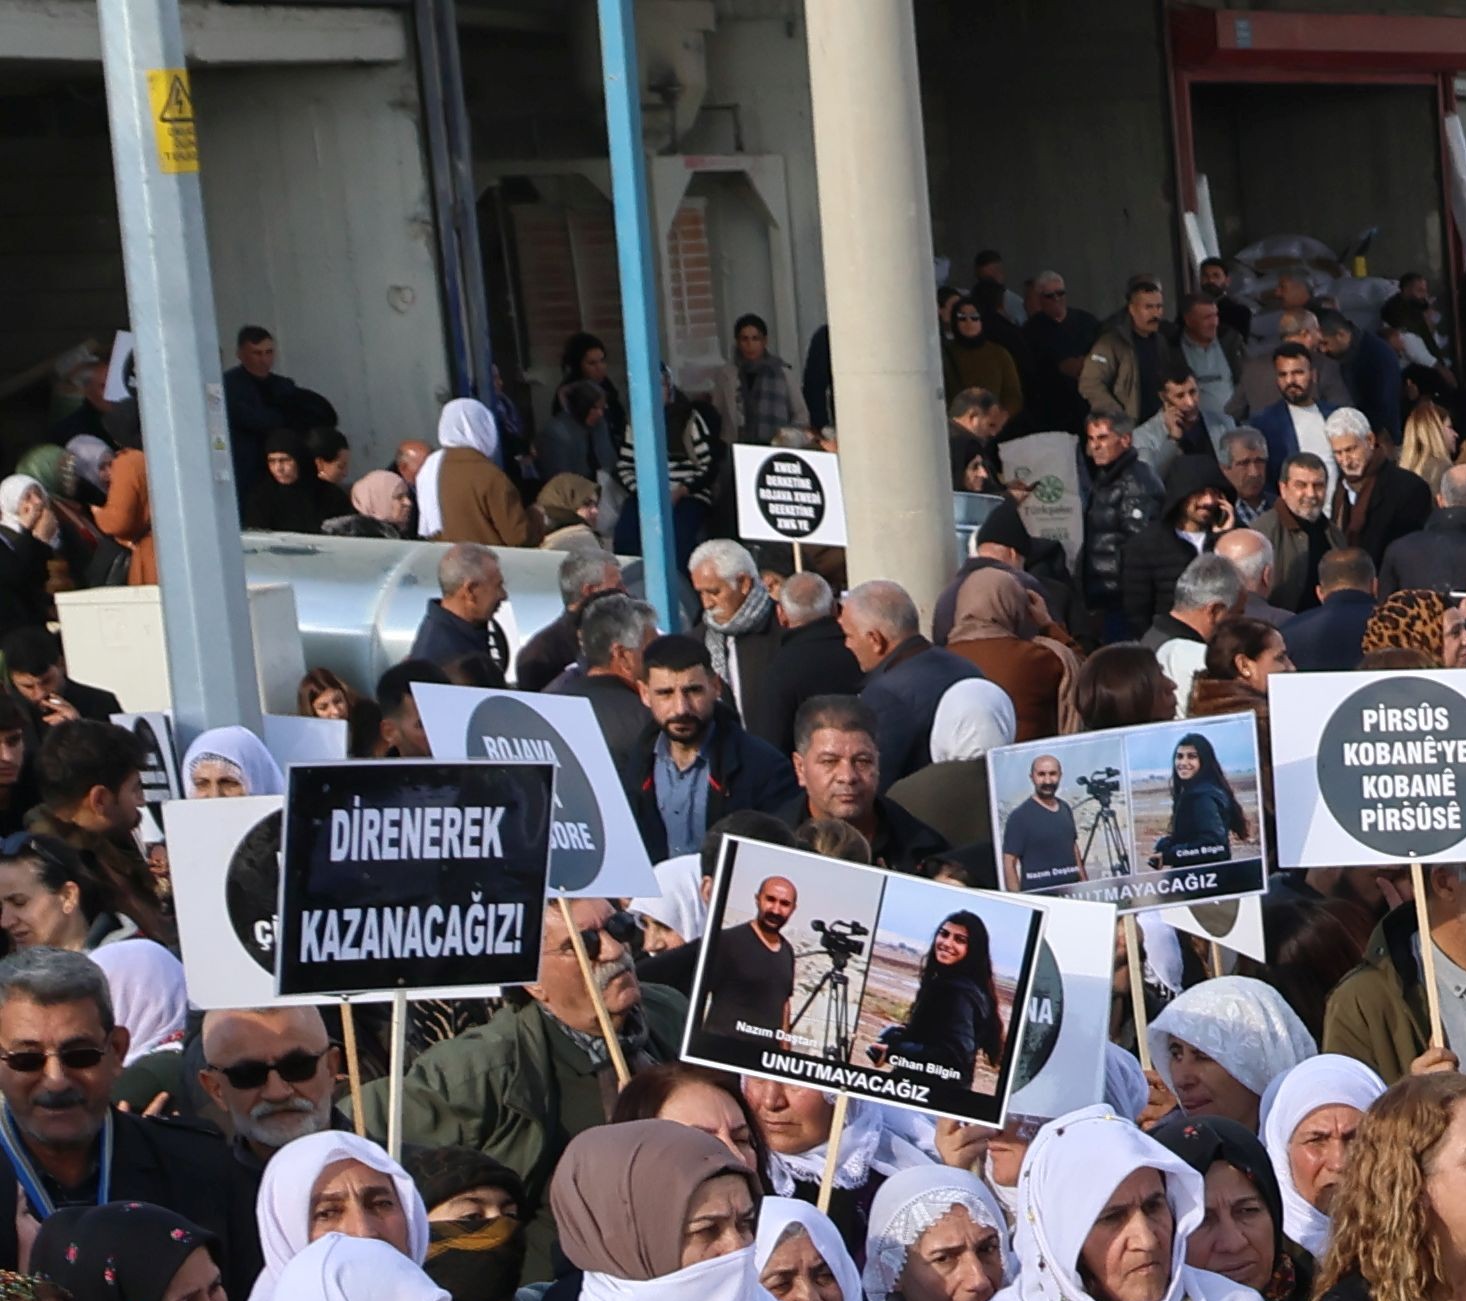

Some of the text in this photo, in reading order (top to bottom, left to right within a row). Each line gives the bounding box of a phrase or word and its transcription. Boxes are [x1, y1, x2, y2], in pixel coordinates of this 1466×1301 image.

[483, 736, 562, 768] ROJAVA
[1362, 767, 1456, 798] KOBANÊ
[330, 796, 504, 863] DİRENEREK
[1059, 872, 1219, 902] NUTMAYACAĞIZ
[300, 892, 525, 964] KAZANACAĞIZ!
[736, 1020, 774, 1040] Nazım
[761, 1050, 931, 1103] UNUTMAYACAĞIZ
[888, 1054, 962, 1081] Cihan Bilgin
